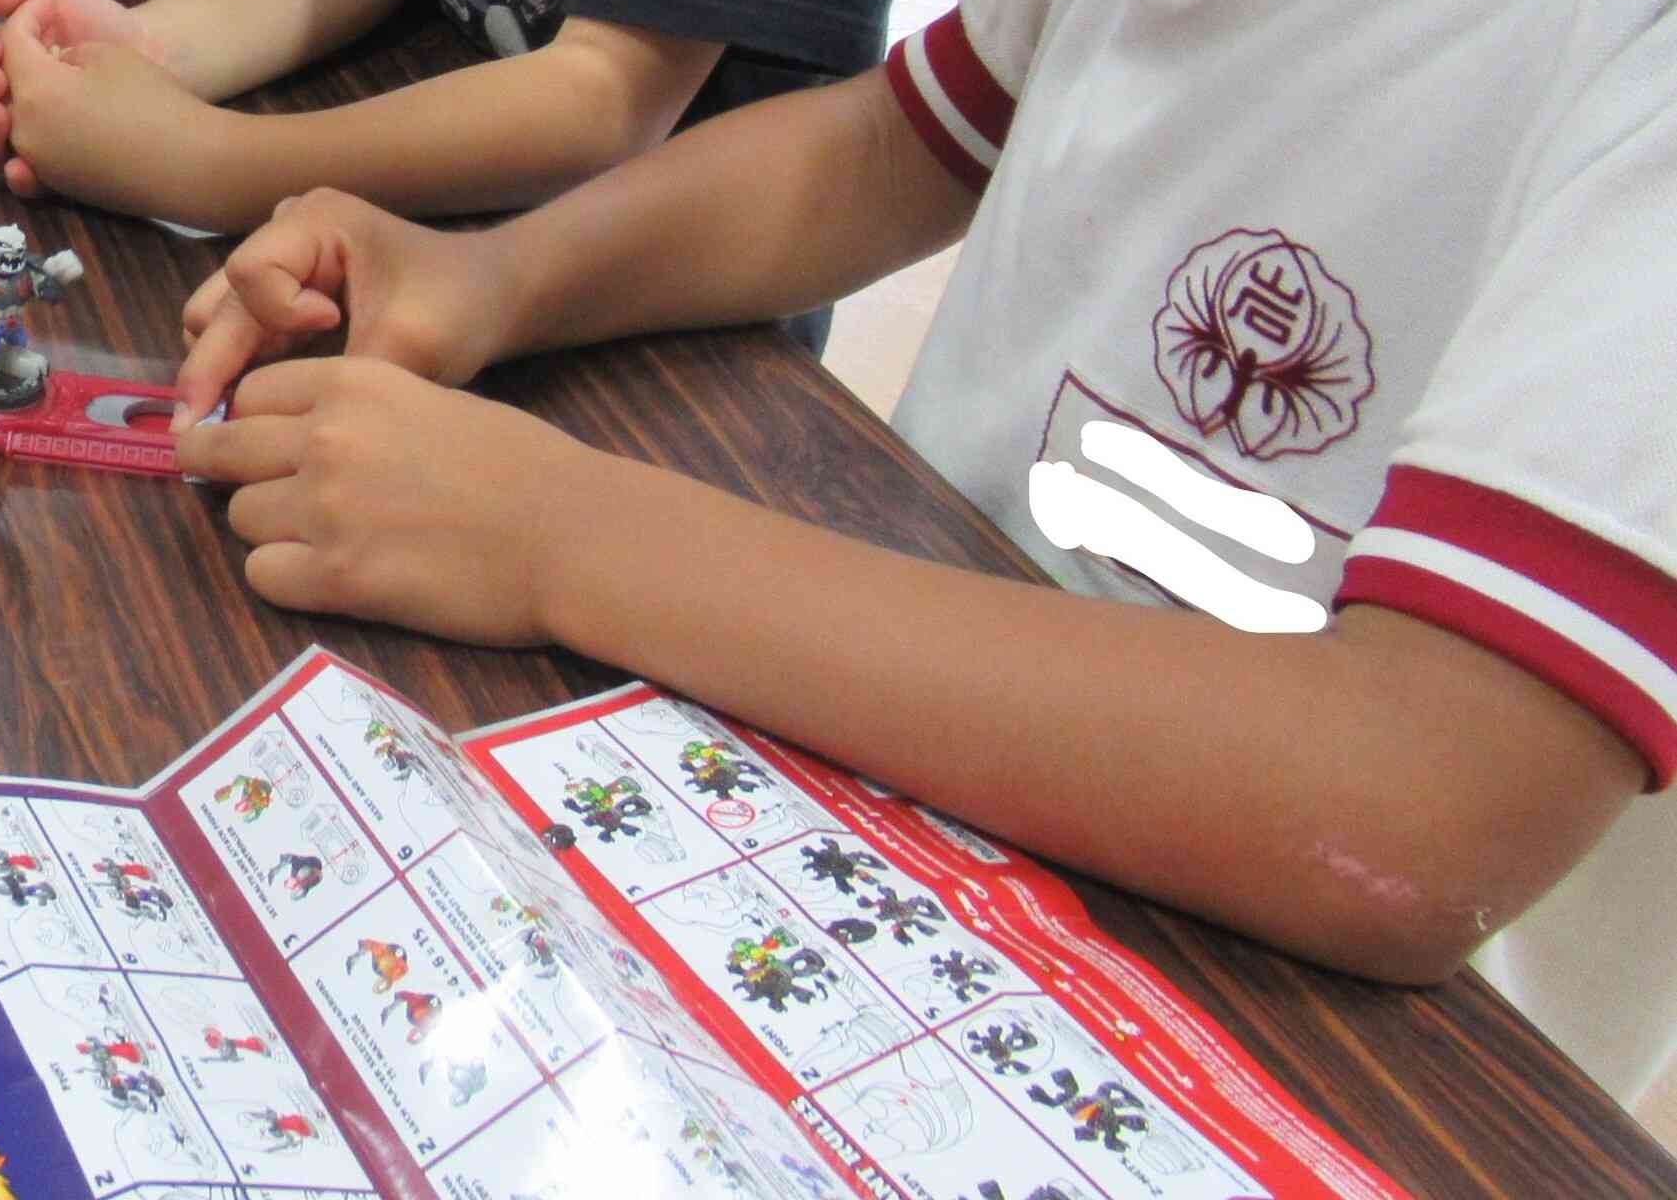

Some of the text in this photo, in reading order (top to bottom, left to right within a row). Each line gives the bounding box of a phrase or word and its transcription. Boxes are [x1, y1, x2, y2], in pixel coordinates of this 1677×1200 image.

[395, 843, 414, 862] 6
[395, 843, 414, 862] 6
[281, 931, 300, 948] 3
[788, 1093, 862, 1168] RULES
[417, 1137, 436, 1154] 2
[95, 1170, 114, 1187] 2
